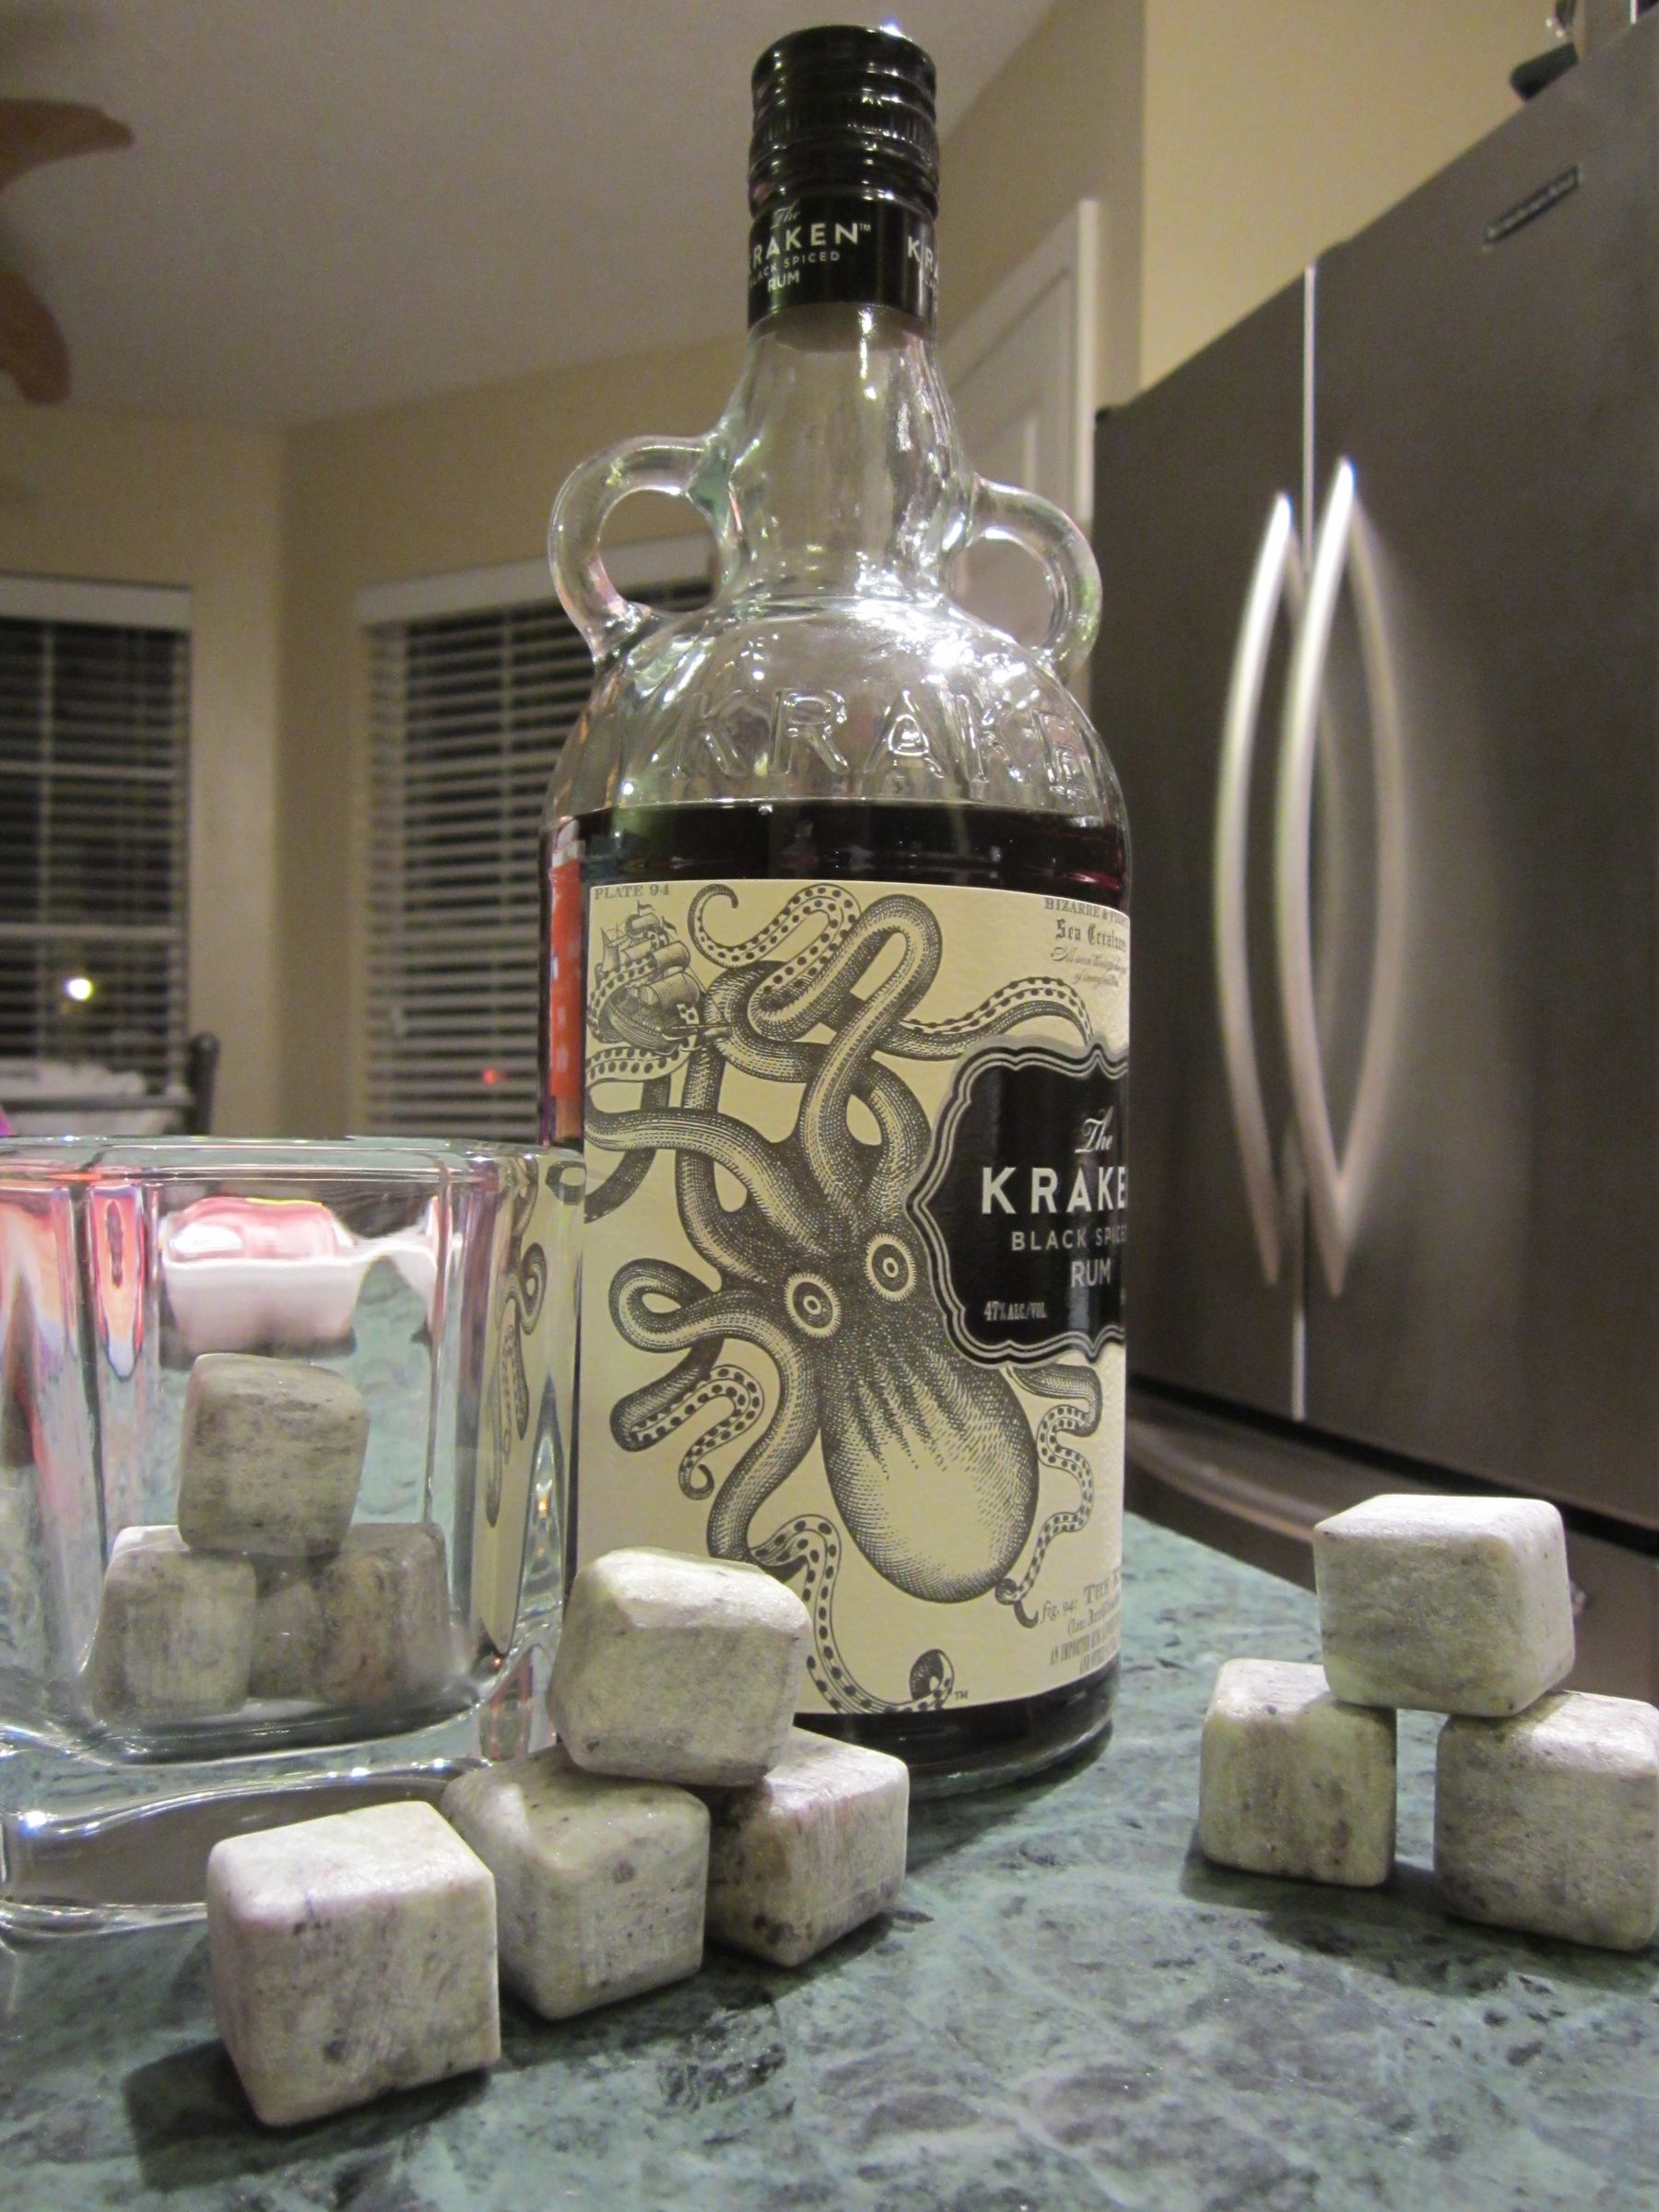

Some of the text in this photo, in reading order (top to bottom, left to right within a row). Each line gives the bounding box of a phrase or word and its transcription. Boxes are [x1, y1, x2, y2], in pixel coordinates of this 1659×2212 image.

[783, 251, 841, 268] SPICED
[768, 271, 800, 292] RUM
[594, 883, 670, 900] PLATE 94
[1045, 898, 1100, 918] BIZARRE
[1055, 918, 1081, 941] Sea
[1075, 1106, 1113, 1153] The
[982, 1167, 1126, 1215] KRAKE
[1011, 1230, 1088, 1252] BLACK
[1070, 1259, 1111, 1288] RUM
